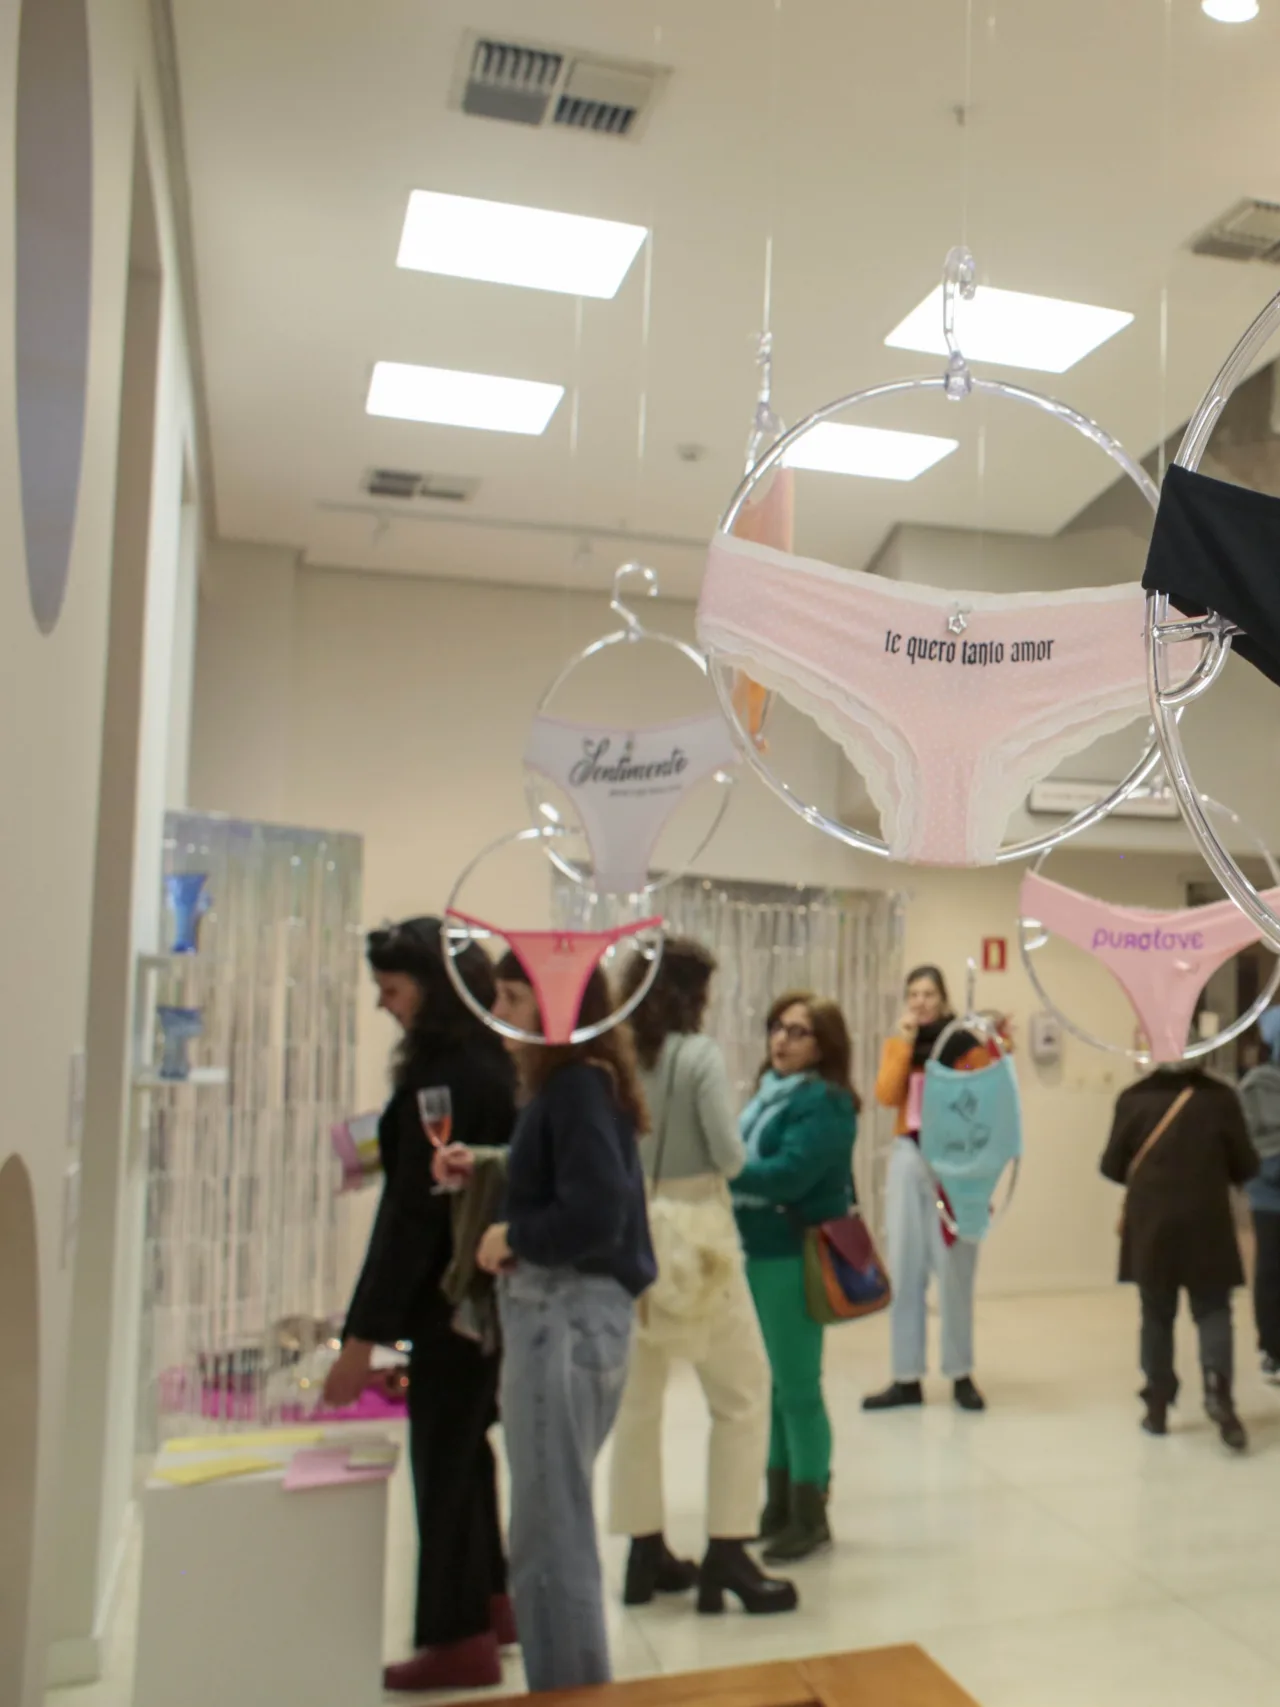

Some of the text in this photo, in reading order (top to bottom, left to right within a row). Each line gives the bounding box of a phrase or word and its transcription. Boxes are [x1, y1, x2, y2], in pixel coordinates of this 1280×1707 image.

[907, 635, 956, 665] quero
[961, 640, 1004, 667] tanto
[1010, 639, 1054, 663] amor
